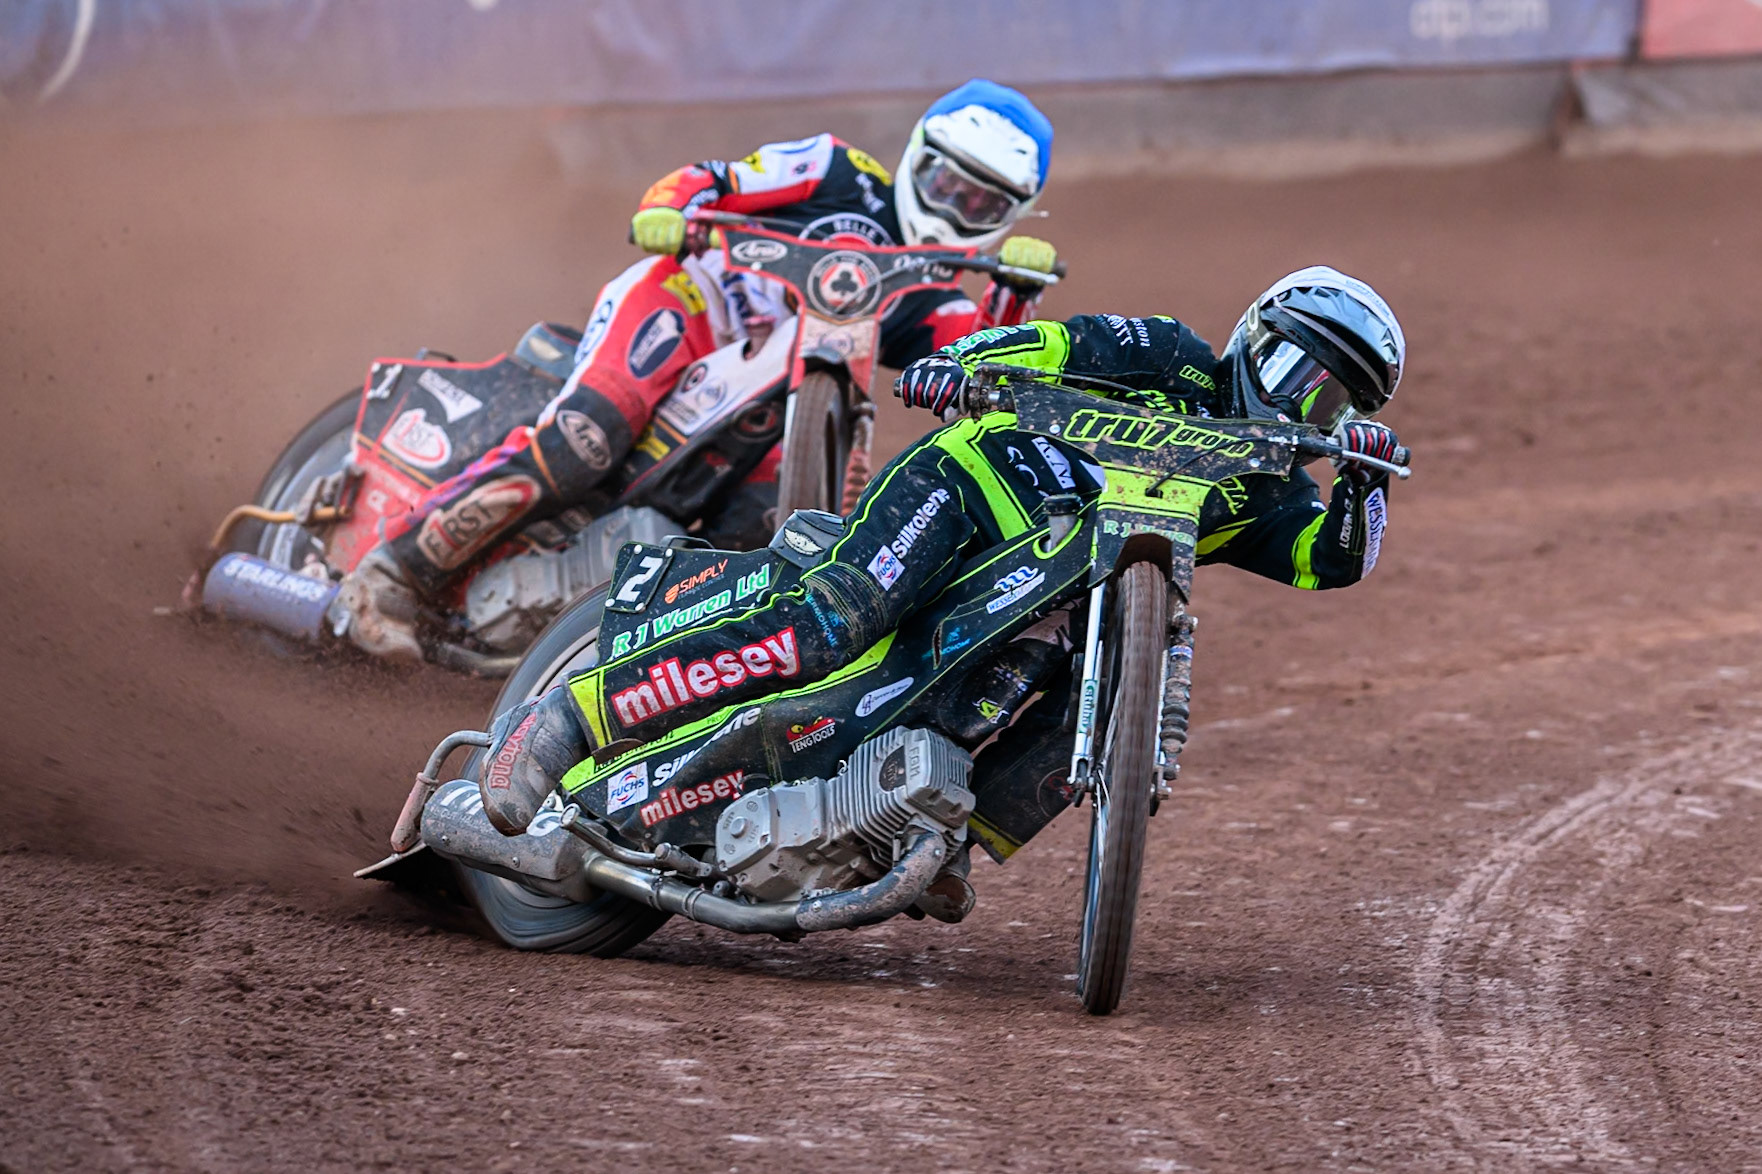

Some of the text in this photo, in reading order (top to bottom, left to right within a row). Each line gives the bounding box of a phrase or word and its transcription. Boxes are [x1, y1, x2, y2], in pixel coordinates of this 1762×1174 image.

[890, 488, 951, 560] silkolene
[1103, 520, 1119, 535] R
[615, 556, 663, 602] 2
[678, 558, 729, 595] SIMPLY
[612, 631, 633, 658] R
[652, 589, 732, 639] Warren
[735, 563, 770, 602] Ltd
[611, 626, 799, 728] milesey
[610, 777, 646, 799] FUCHS
[640, 768, 745, 828] milesey
